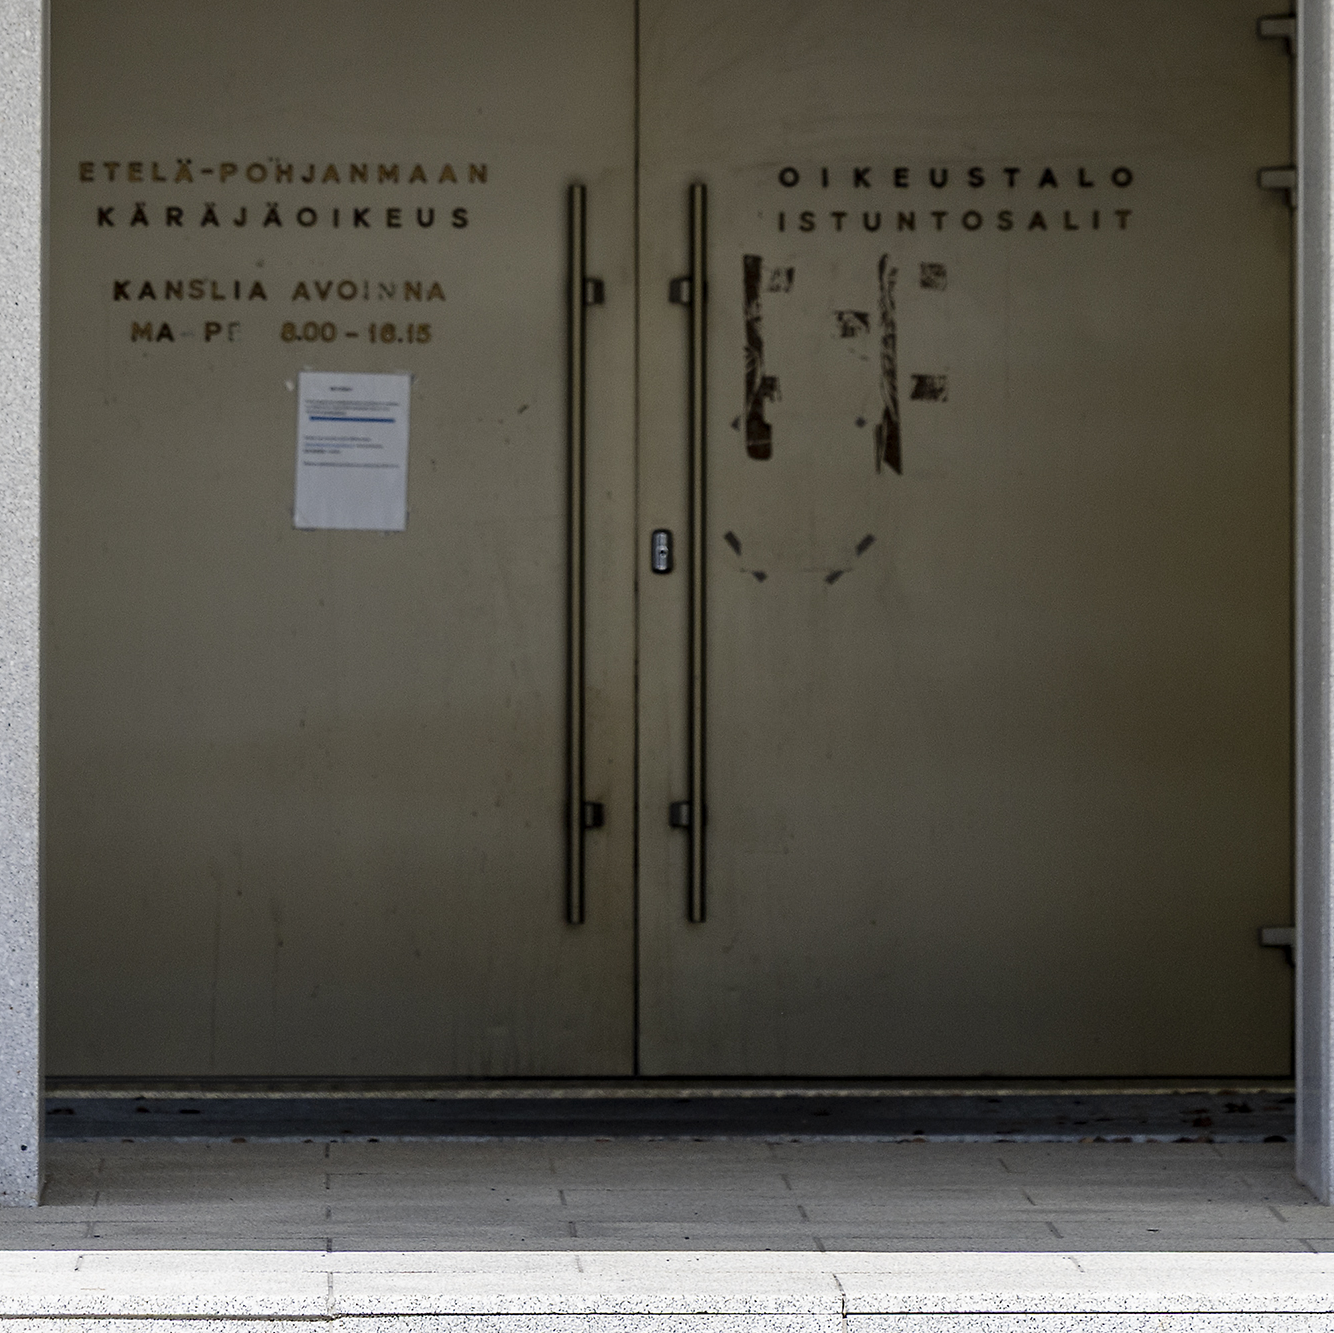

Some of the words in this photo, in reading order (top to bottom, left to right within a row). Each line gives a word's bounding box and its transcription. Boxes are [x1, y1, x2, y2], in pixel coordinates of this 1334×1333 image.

[78, 157, 489, 184] ETELÄ-POHJANMAAN
[777, 166, 1135, 189] OIKEUSTALO
[96, 201, 469, 229] KÄRÄJÄOIKEUS
[777, 209, 1133, 233] ISTUNTOSALIT
[112, 279, 269, 302] KANSLIA
[290, 279, 447, 302] AVOINNA
